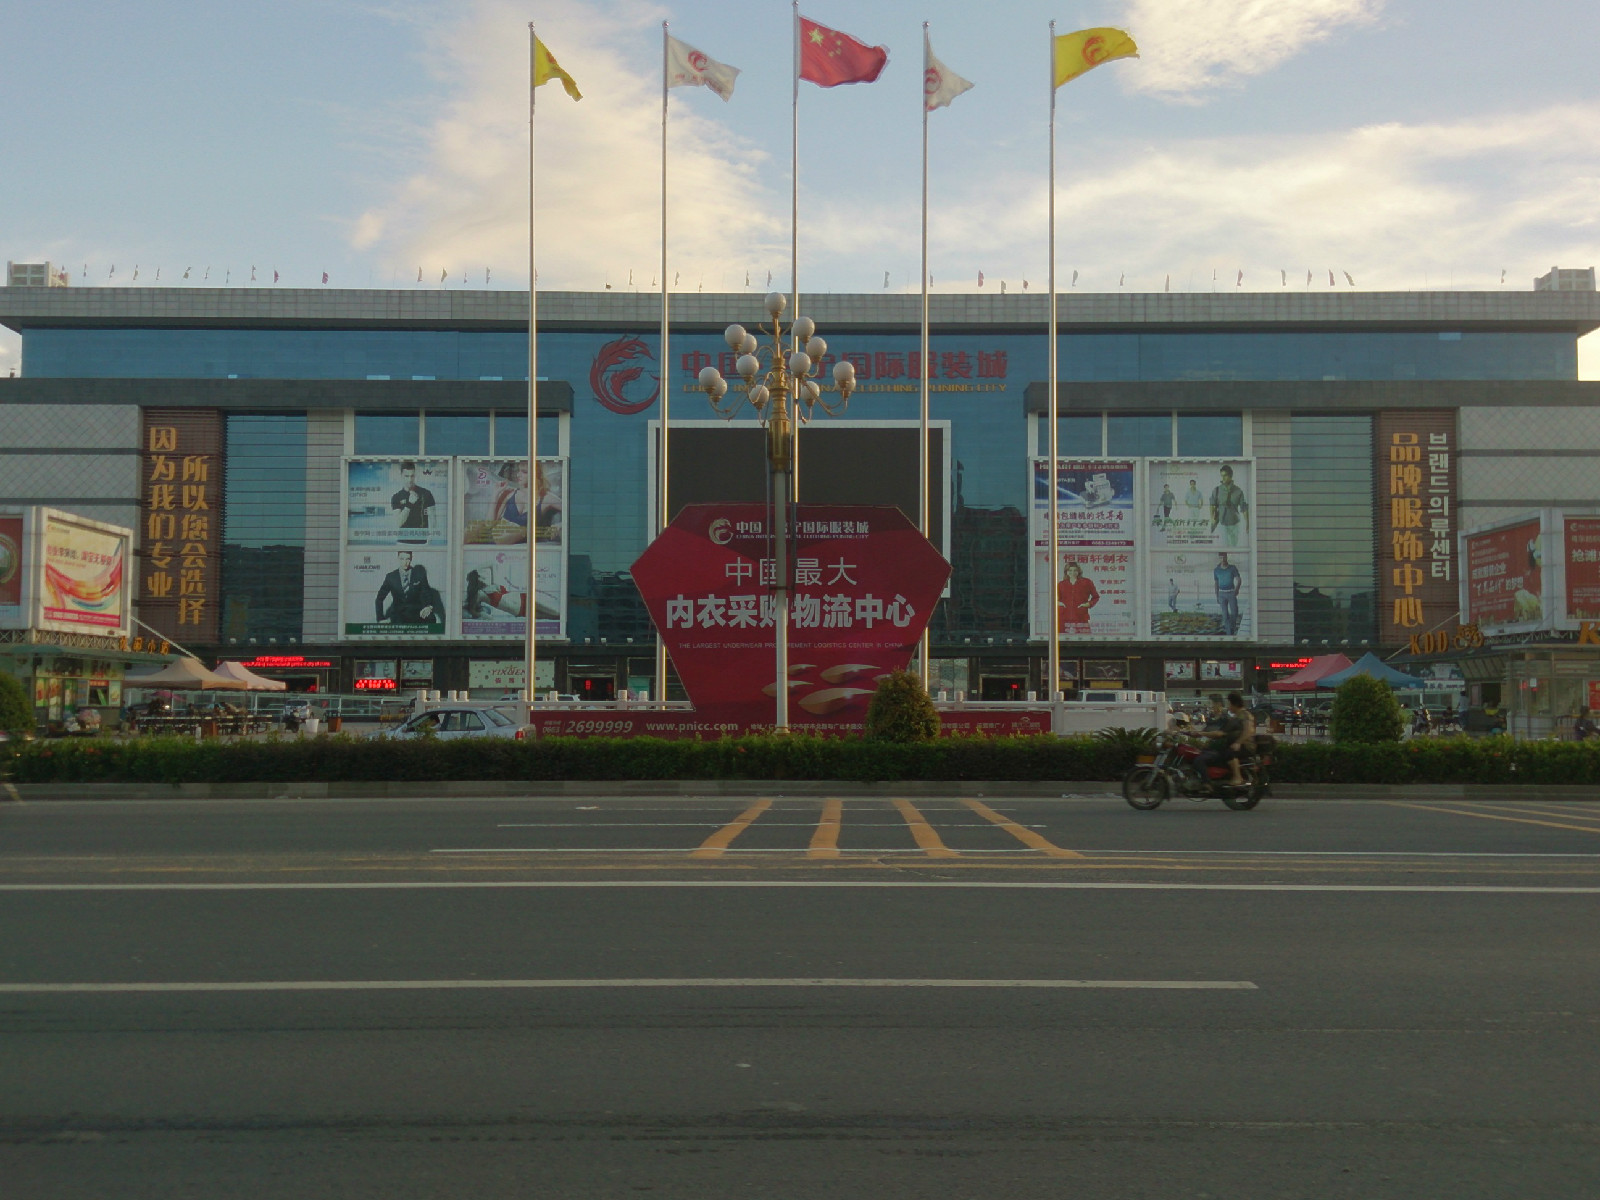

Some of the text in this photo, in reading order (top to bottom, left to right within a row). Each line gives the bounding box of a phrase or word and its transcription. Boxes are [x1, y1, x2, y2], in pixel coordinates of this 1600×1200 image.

[147, 426, 178, 599] 因为我们专业
[178, 455, 210, 626] 所以您会选择
[1389, 432, 1424, 629] 品牌服饰中心
[1426, 432, 1451, 582] 브랜드의류센터
[666, 593, 916, 630] 内衣采购物流中心
[1409, 630, 1449, 656] KDD
[565, 720, 633, 733] 2699999
[646, 722, 739, 732] www.pnicc.com
